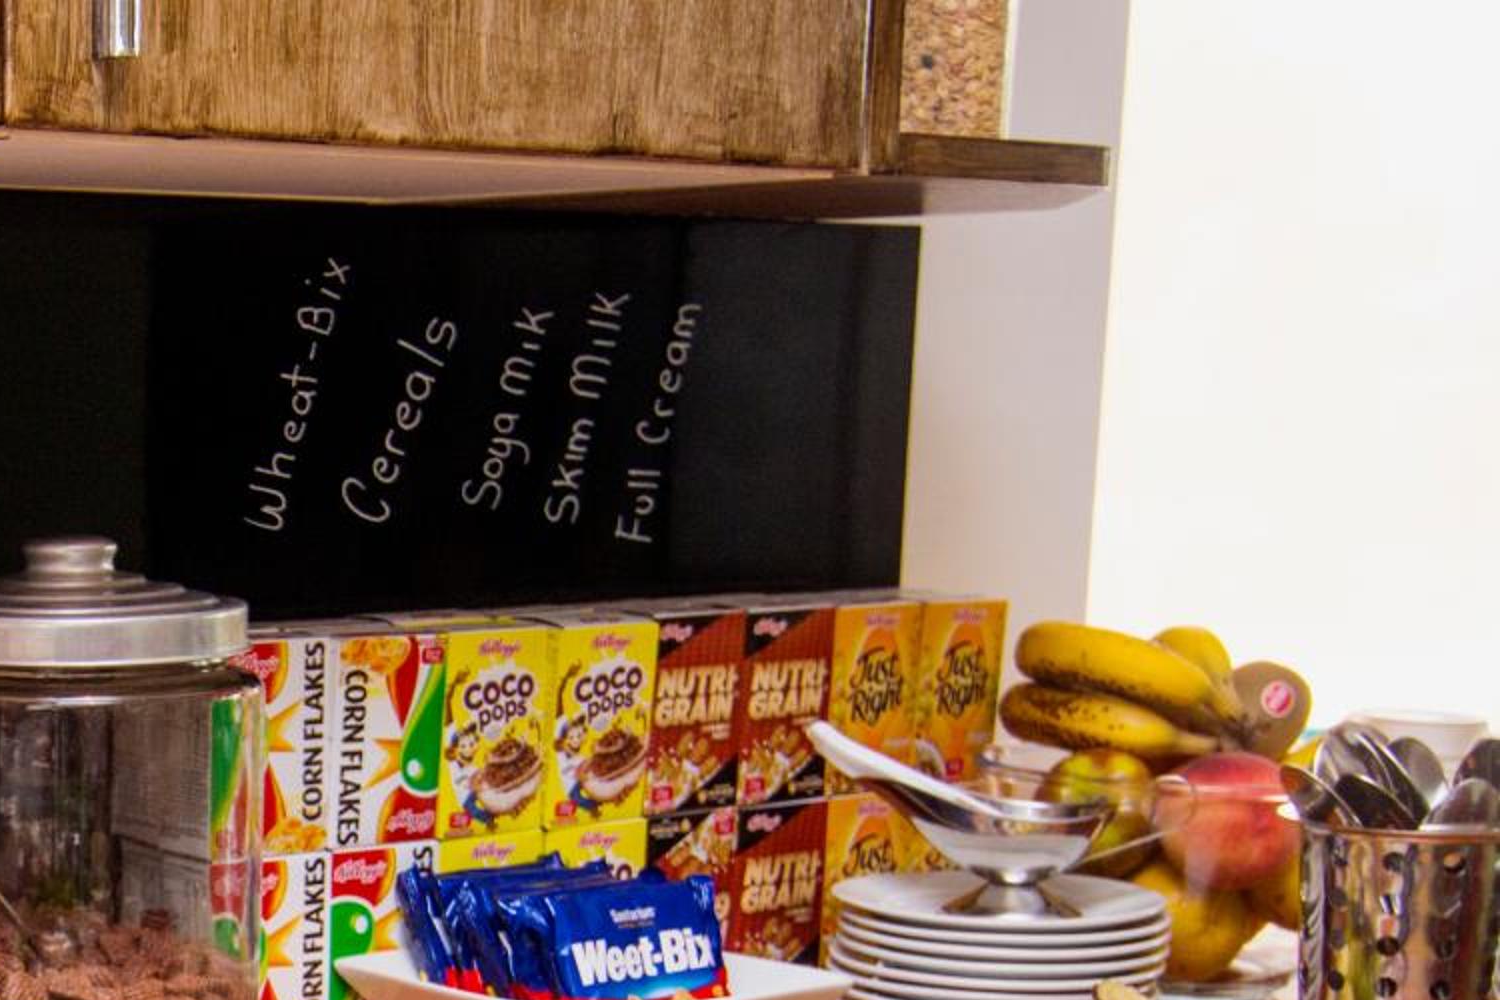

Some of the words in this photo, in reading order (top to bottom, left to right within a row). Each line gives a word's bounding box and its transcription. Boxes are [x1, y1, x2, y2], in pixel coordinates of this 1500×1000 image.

[244, 257, 352, 532] Wheat-Bix
[636, 302, 701, 444] Cream
[341, 316, 458, 523] Cereals
[462, 411, 530, 509] Soya
[544, 417, 594, 524] Skim
[614, 468, 662, 543] Full
[574, 666, 643, 703] COCO
[849, 646, 899, 688] Just
[937, 639, 985, 681] Just
[304, 640, 325, 741] FLAKES
[341, 669, 368, 744] CORN
[463, 673, 534, 710] COCO
[478, 700, 527, 734] pops
[587, 691, 635, 724] pops
[655, 692, 734, 727] GRAIN
[748, 686, 823, 721] GRAIN
[848, 675, 904, 727] Right
[935, 670, 989, 720] Right
[302, 747, 324, 822] CORN
[337, 750, 363, 846] FLAKES
[842, 831, 897, 878] Just
[303, 858, 326, 954] FLAKES
[739, 878, 818, 914] GRAIN
[571, 926, 717, 989] Weet-Bix
